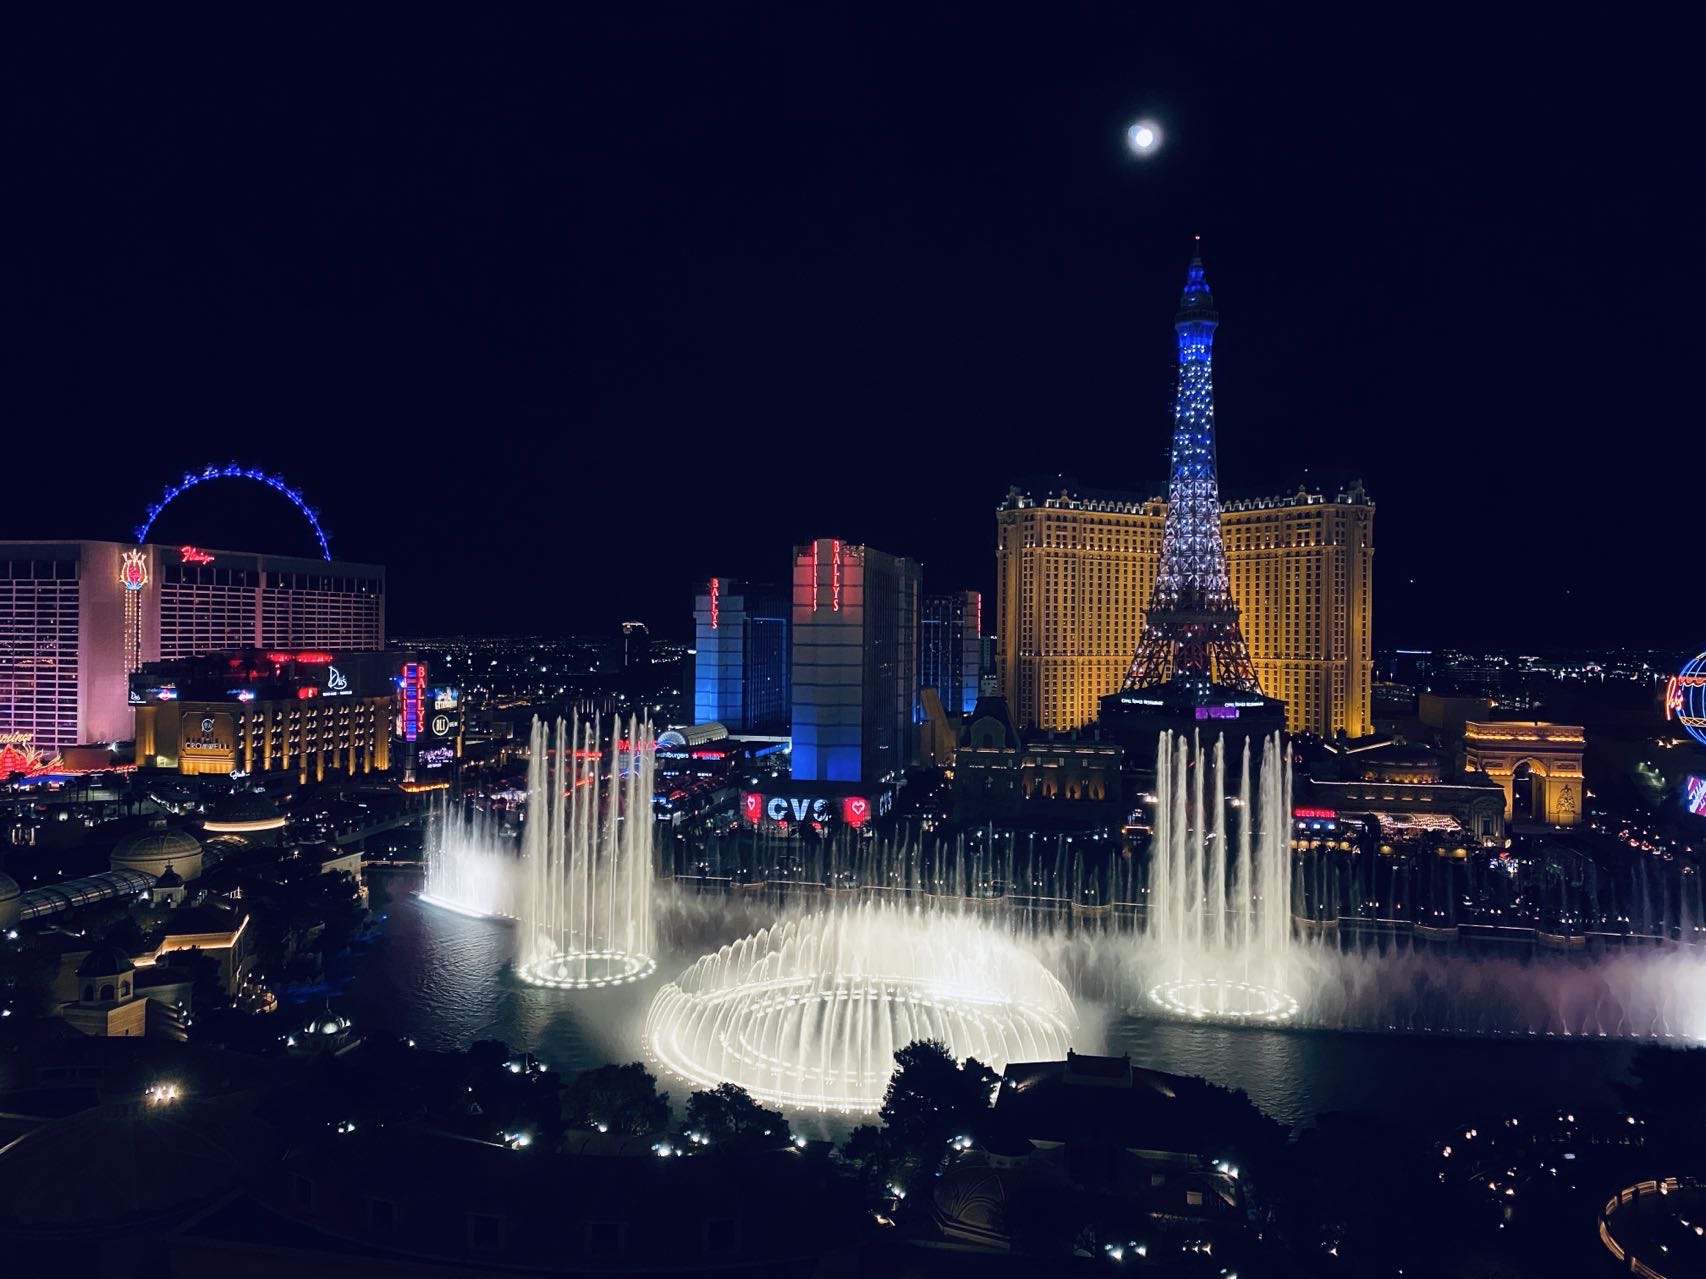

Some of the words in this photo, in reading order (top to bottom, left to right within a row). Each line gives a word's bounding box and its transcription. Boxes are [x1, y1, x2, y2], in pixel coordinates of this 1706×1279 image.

[832, 540, 841, 612] BALLYS
[711, 578, 719, 630] BALLYS
[417, 666, 425, 733] BALLYS
[185, 742, 231, 750] CROMWELL
[656, 751, 690, 760] wahlburgers
[767, 797, 832, 821] CVS
